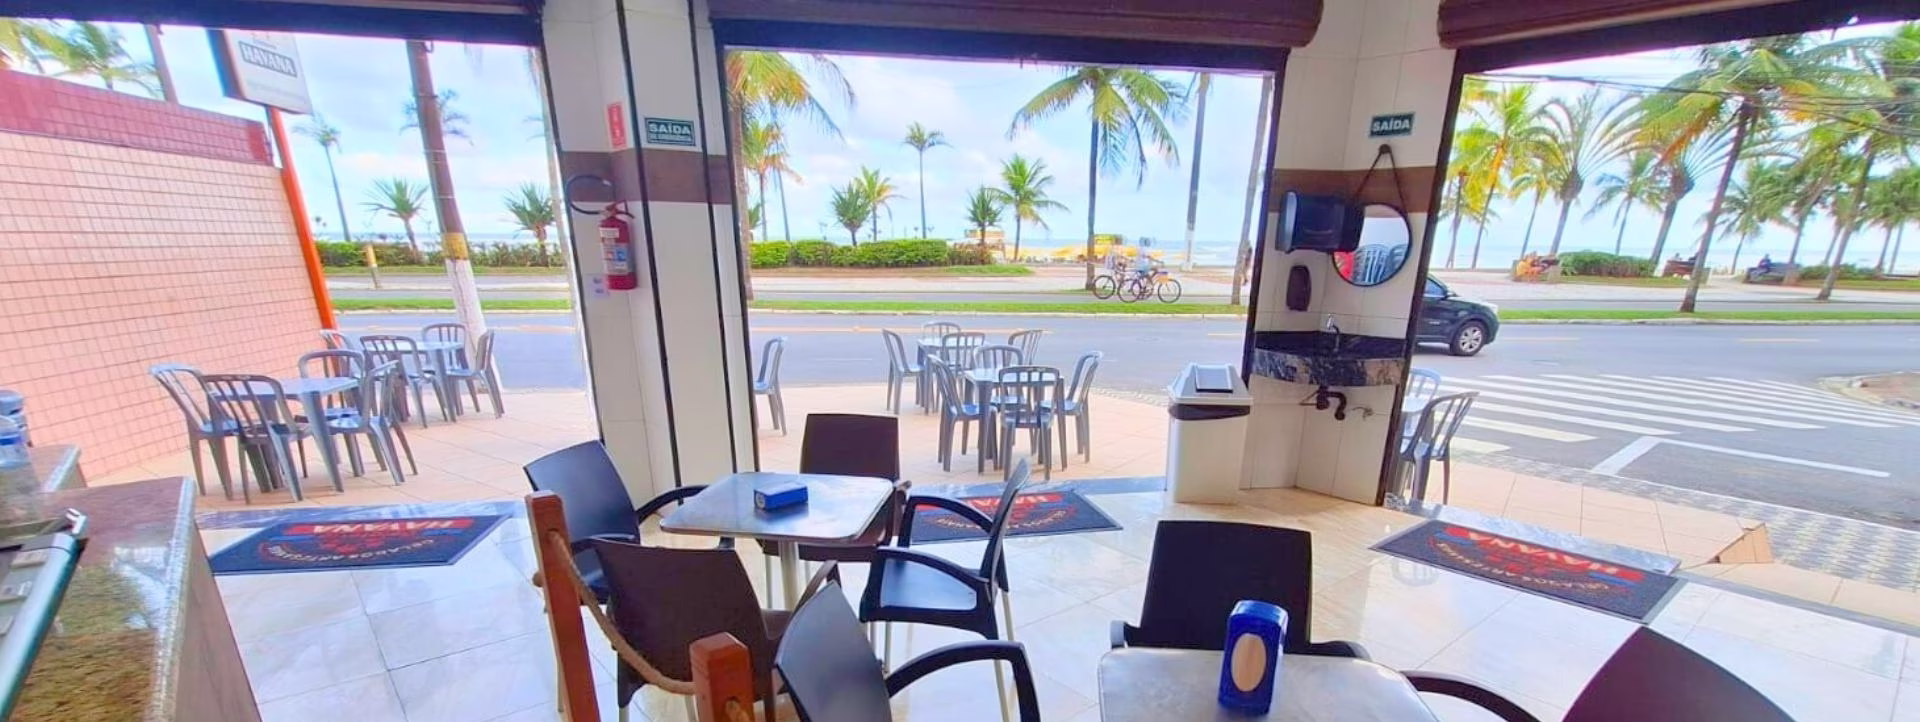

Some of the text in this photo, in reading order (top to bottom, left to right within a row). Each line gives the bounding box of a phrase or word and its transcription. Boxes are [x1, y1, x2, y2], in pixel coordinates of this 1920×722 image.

[241, 43, 296, 76] HAVANA
[648, 121, 691, 135] SAÍDA
[1373, 117, 1410, 131] SAÍDA
[313, 520, 454, 534] HAVANA
[1468, 531, 1620, 574] HAVANA
